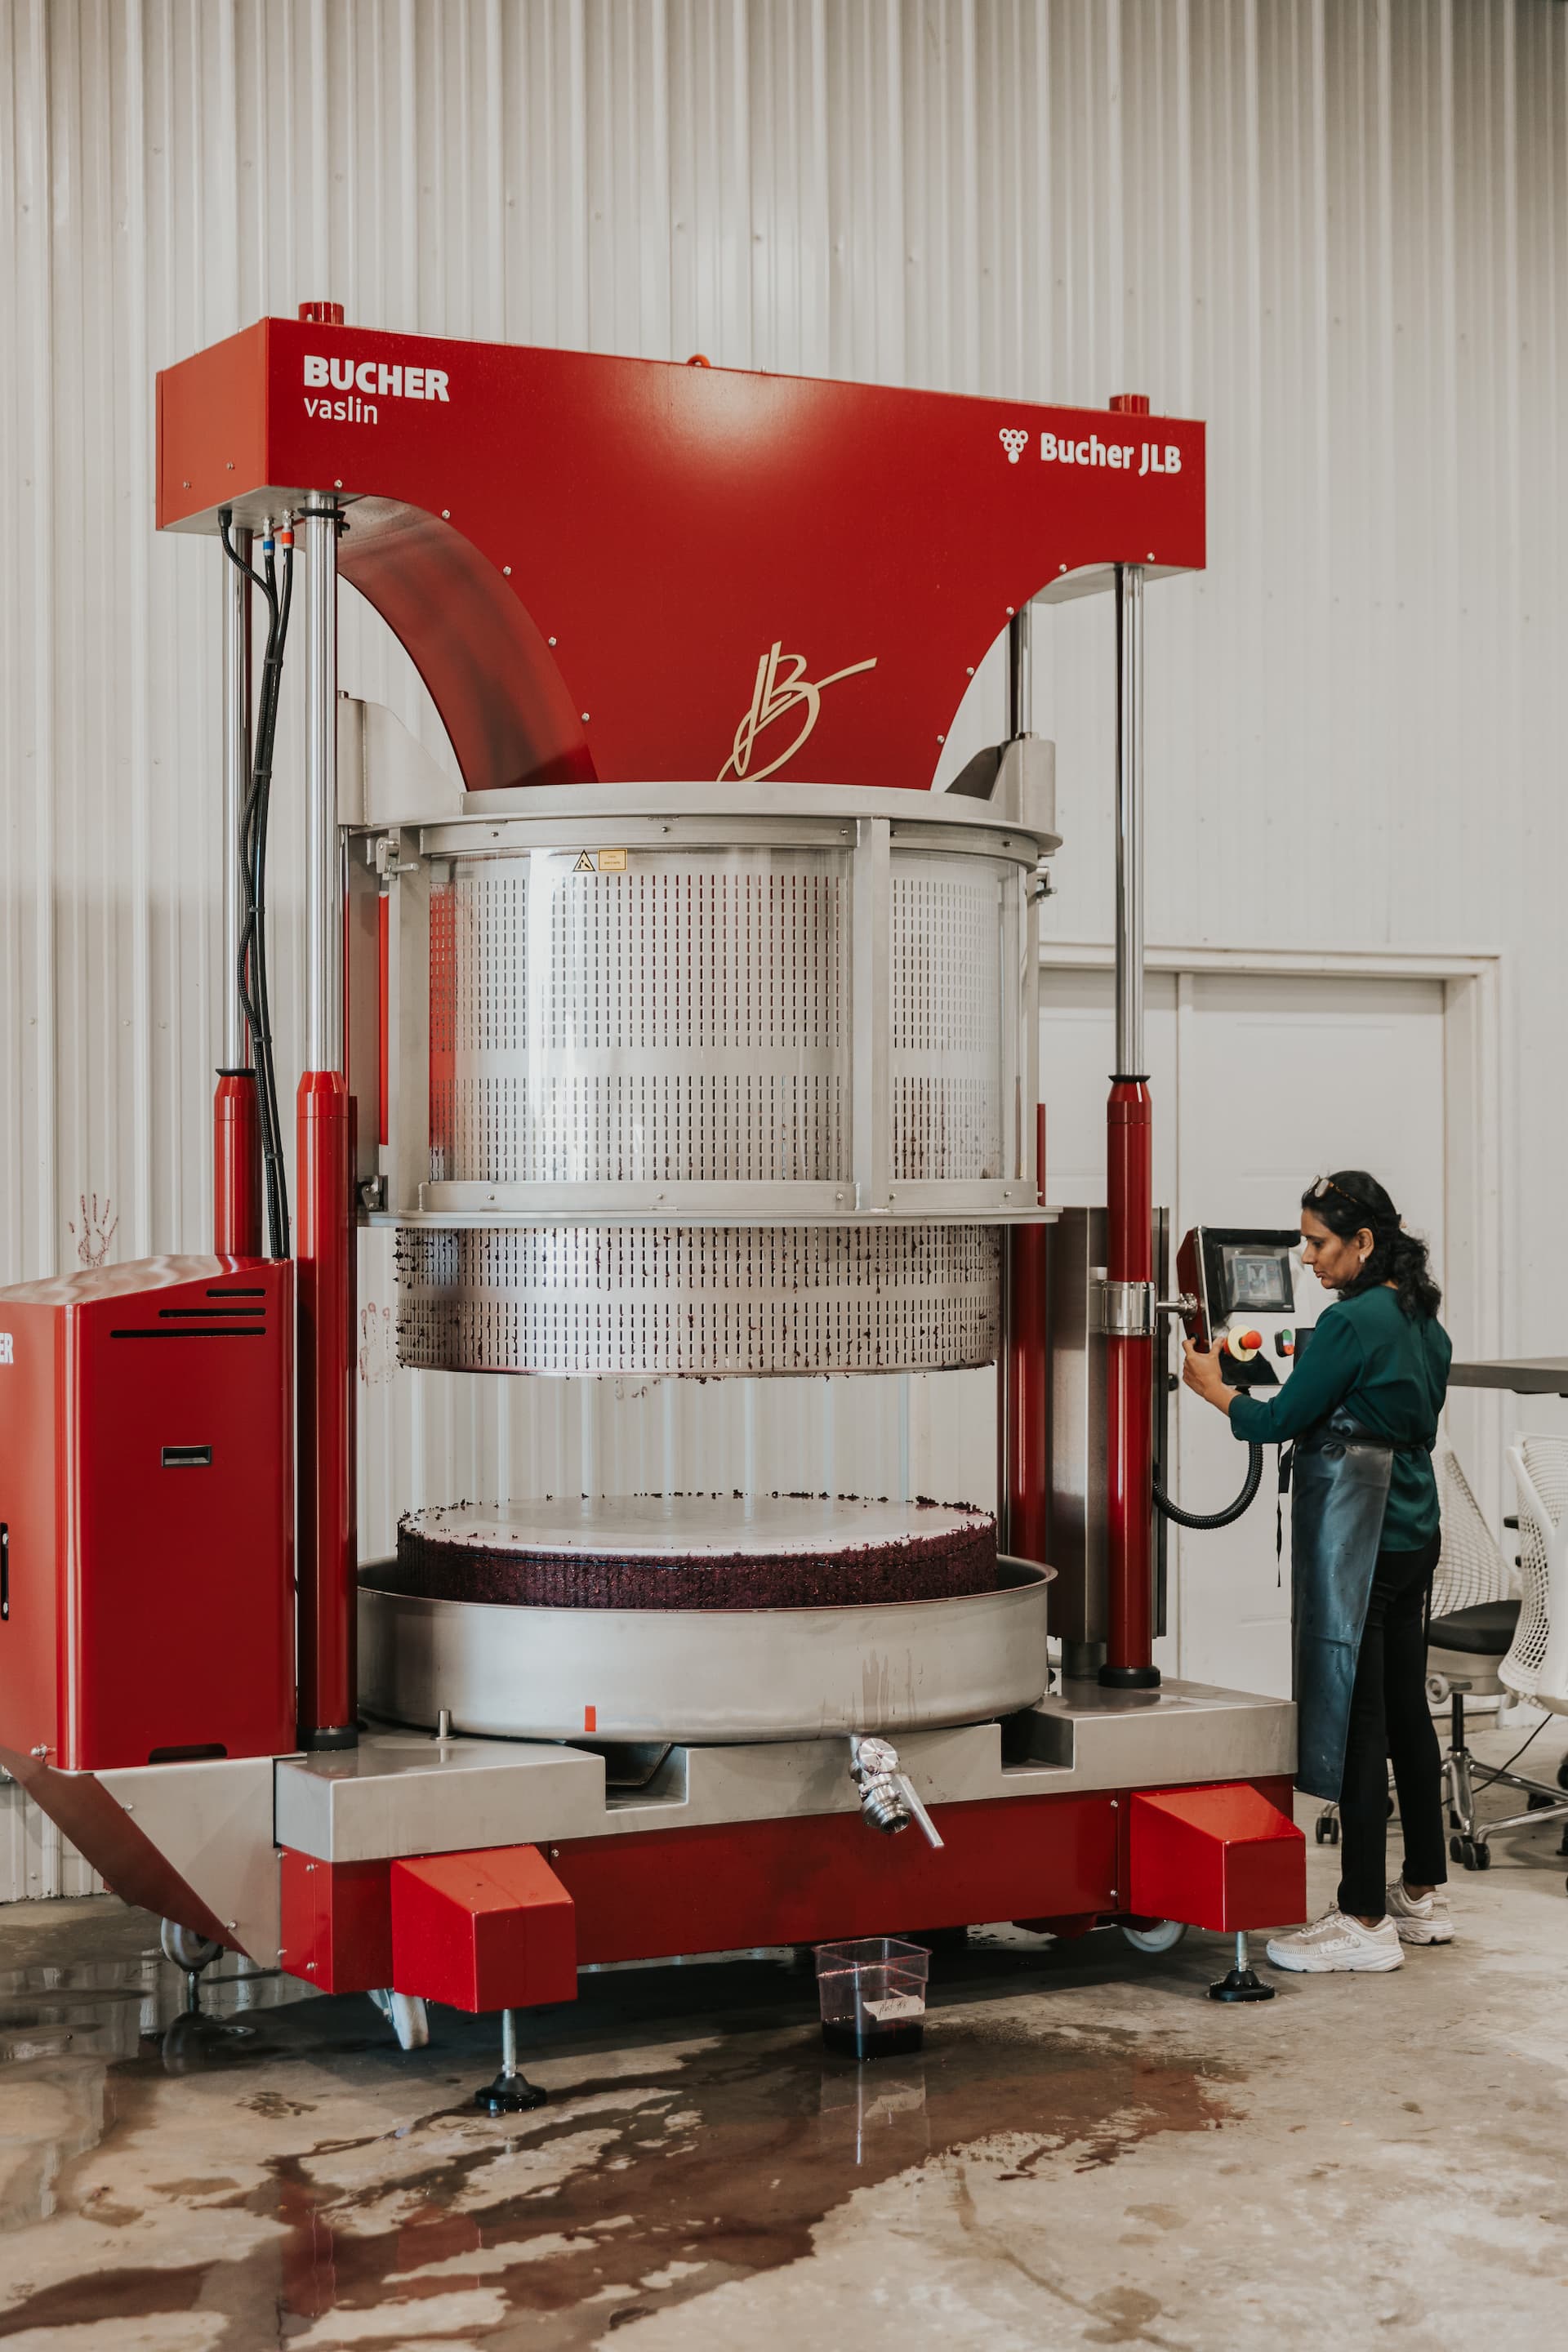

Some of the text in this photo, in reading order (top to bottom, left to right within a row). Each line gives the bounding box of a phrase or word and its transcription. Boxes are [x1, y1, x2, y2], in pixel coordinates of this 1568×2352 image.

[304, 355, 450, 402] BUCHER
[304, 396, 377, 425] vaslin
[1040, 432, 1183, 477] Bucher JLB
